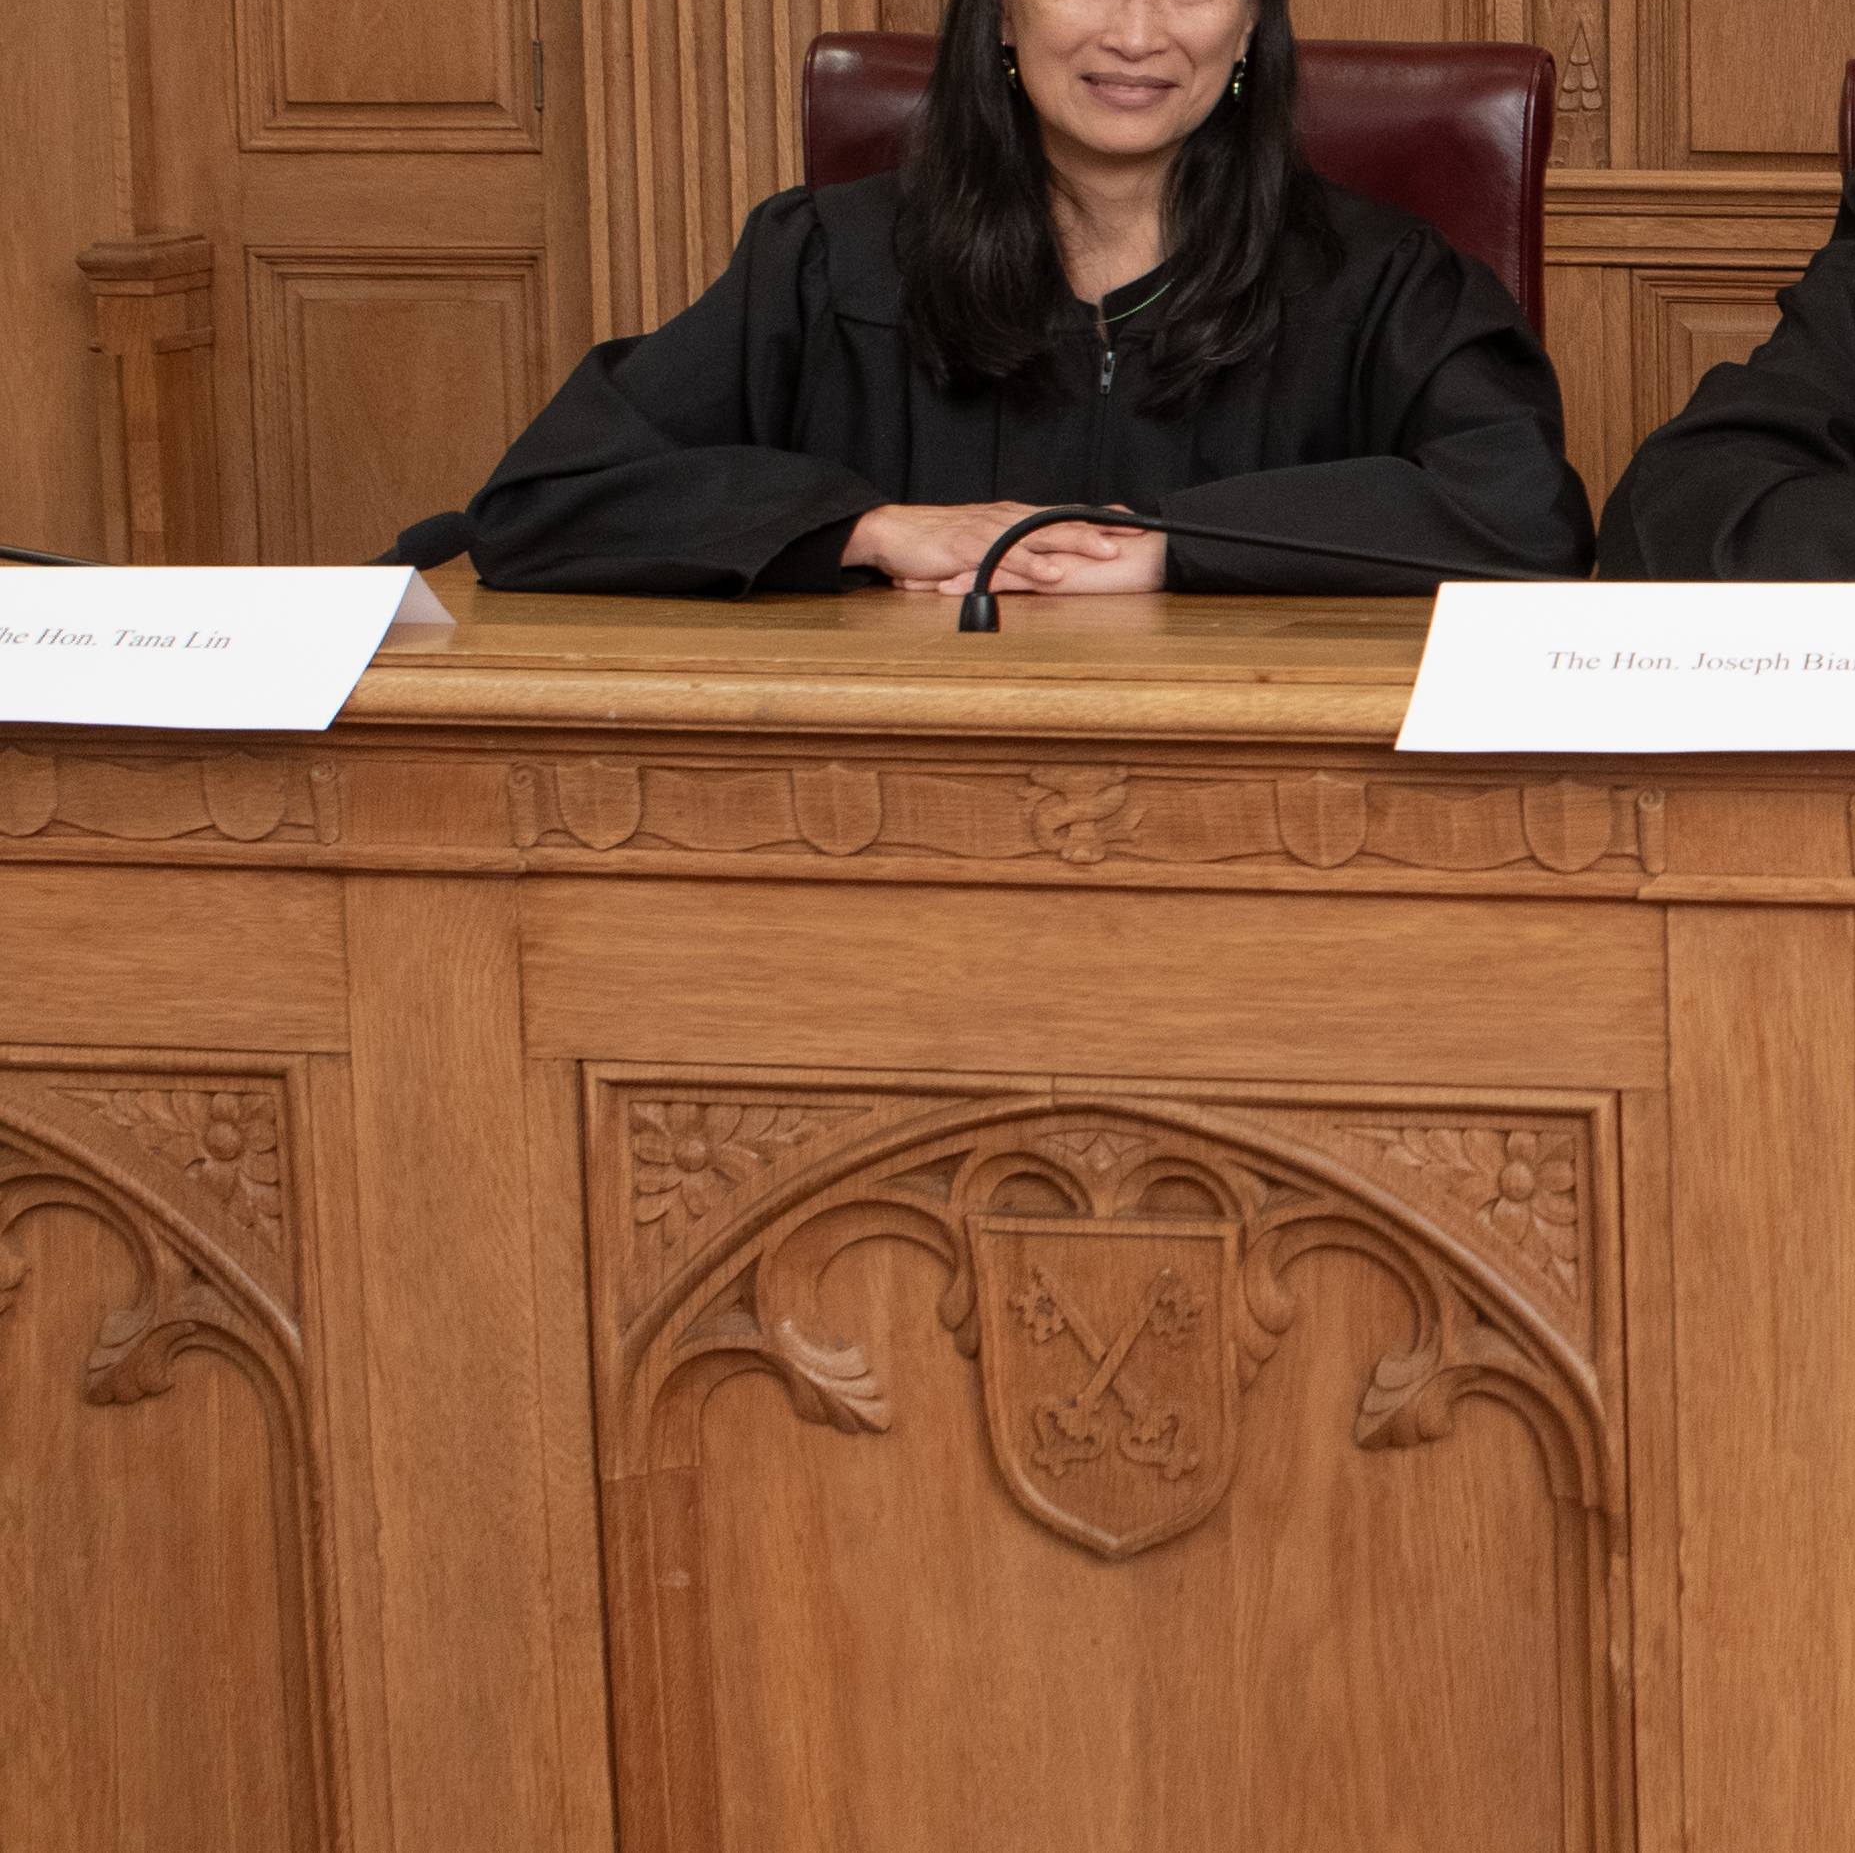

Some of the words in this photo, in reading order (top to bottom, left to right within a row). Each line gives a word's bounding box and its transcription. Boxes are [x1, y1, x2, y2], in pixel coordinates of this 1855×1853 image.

[0, 627, 29, 645] he
[35, 628, 97, 646] Hon.
[114, 629, 176, 648] Tana
[184, 630, 231, 649] Lin
[1548, 652, 1600, 670] The
[1612, 652, 1681, 671] Hon.
[1691, 652, 1790, 676] Joseph
